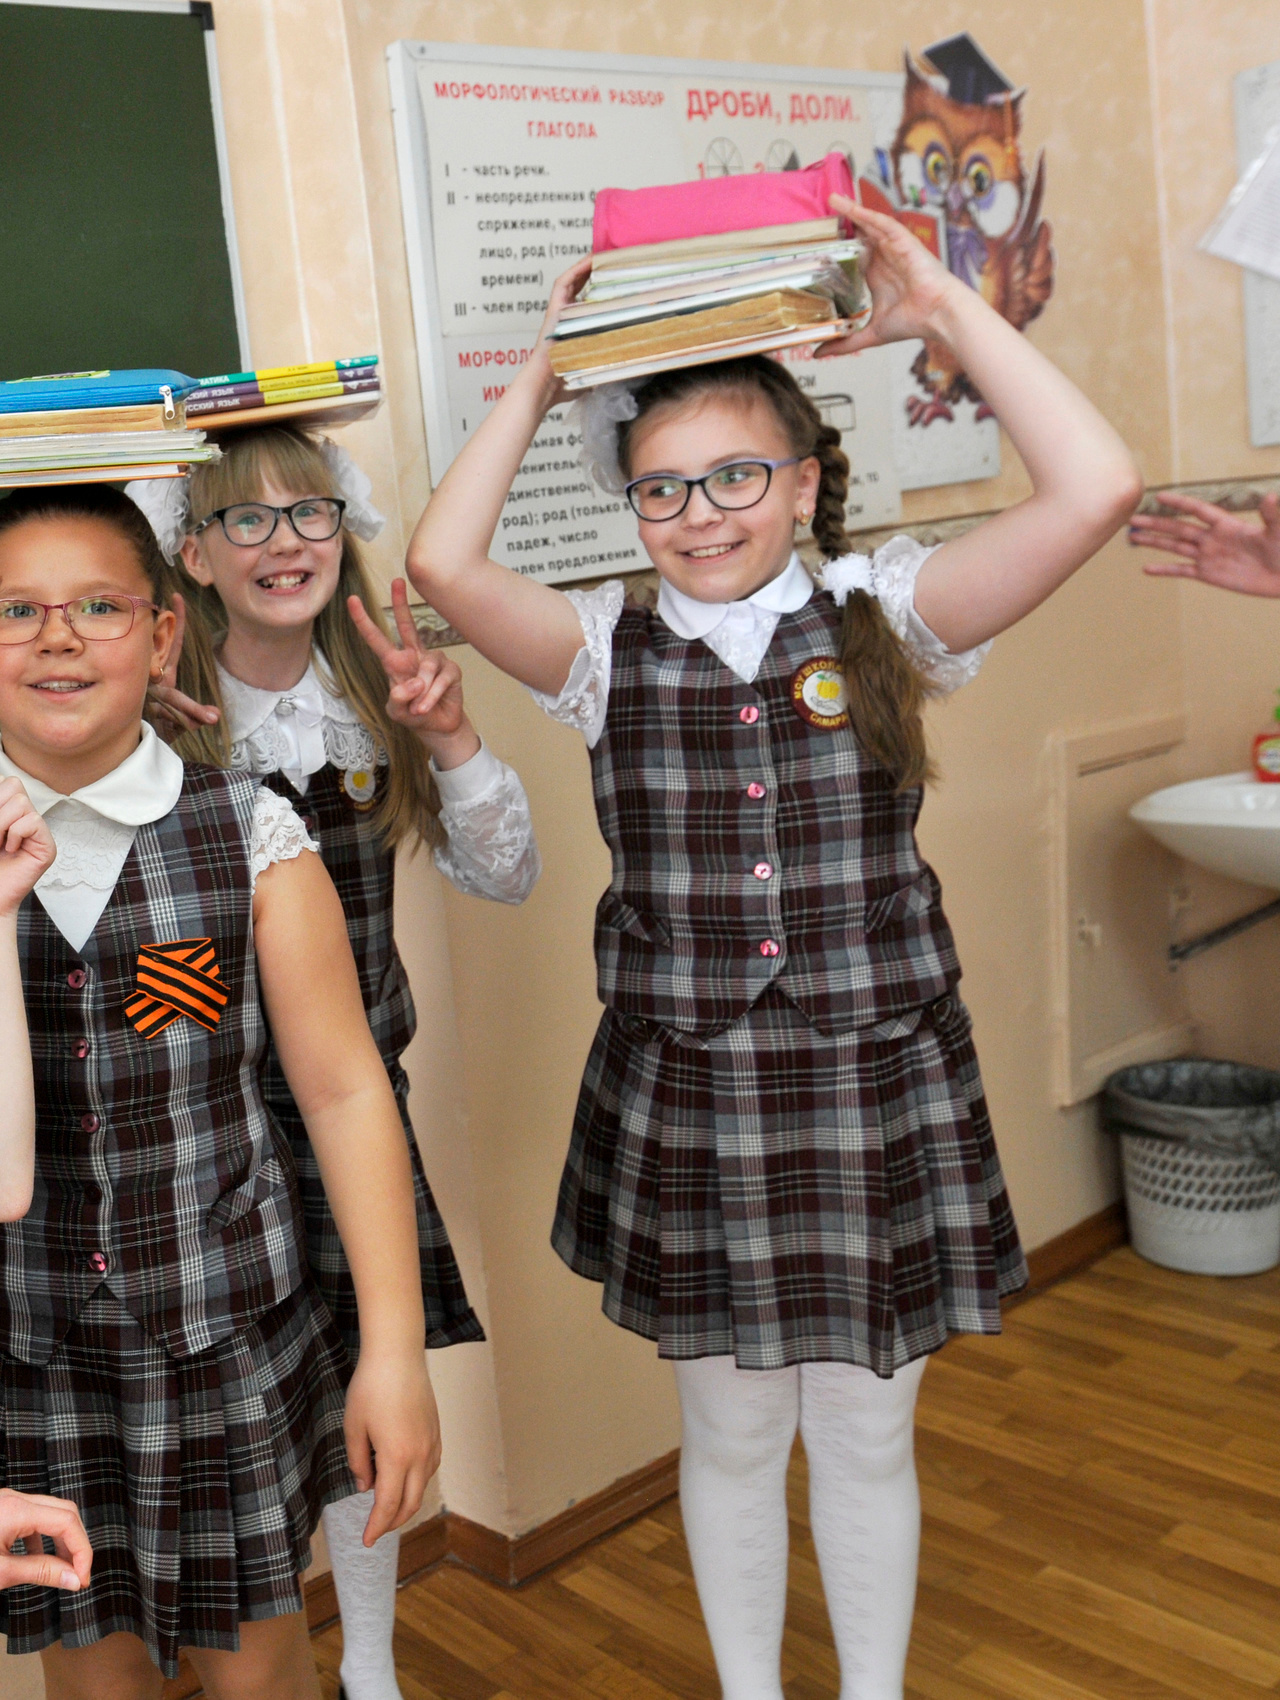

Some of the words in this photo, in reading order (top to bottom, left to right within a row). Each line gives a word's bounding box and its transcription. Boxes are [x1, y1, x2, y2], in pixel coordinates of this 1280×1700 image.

[433, 81, 601, 103] МОРФОЛОГИЧЕСКИЙ
[609, 88, 666, 106] РАЗБОР
[687, 88, 782, 124] ДРОБИ,
[789, 93, 860, 124] ДОЛИ.
[527, 120, 598, 138] ГЛАГОЛА
[473, 163, 511, 178] часть
[475, 191, 586, 206] неопределенная
[477, 216, 556, 234] спряжение,
[521, 245, 547, 261] род
[481, 270, 544, 288] времени)
[483, 303, 515, 314] член
[517, 301, 548, 314] пред
[212, 387, 234, 397] ЯЗЫК
[217, 398, 240, 408] ЯЗЫК
[501, 511, 540, 531] род);
[542, 508, 568, 524] род
[570, 502, 620, 520] (только
[506, 536, 556, 553] падеж,
[558, 529, 598, 544] число
[548, 547, 638, 571] предложения
